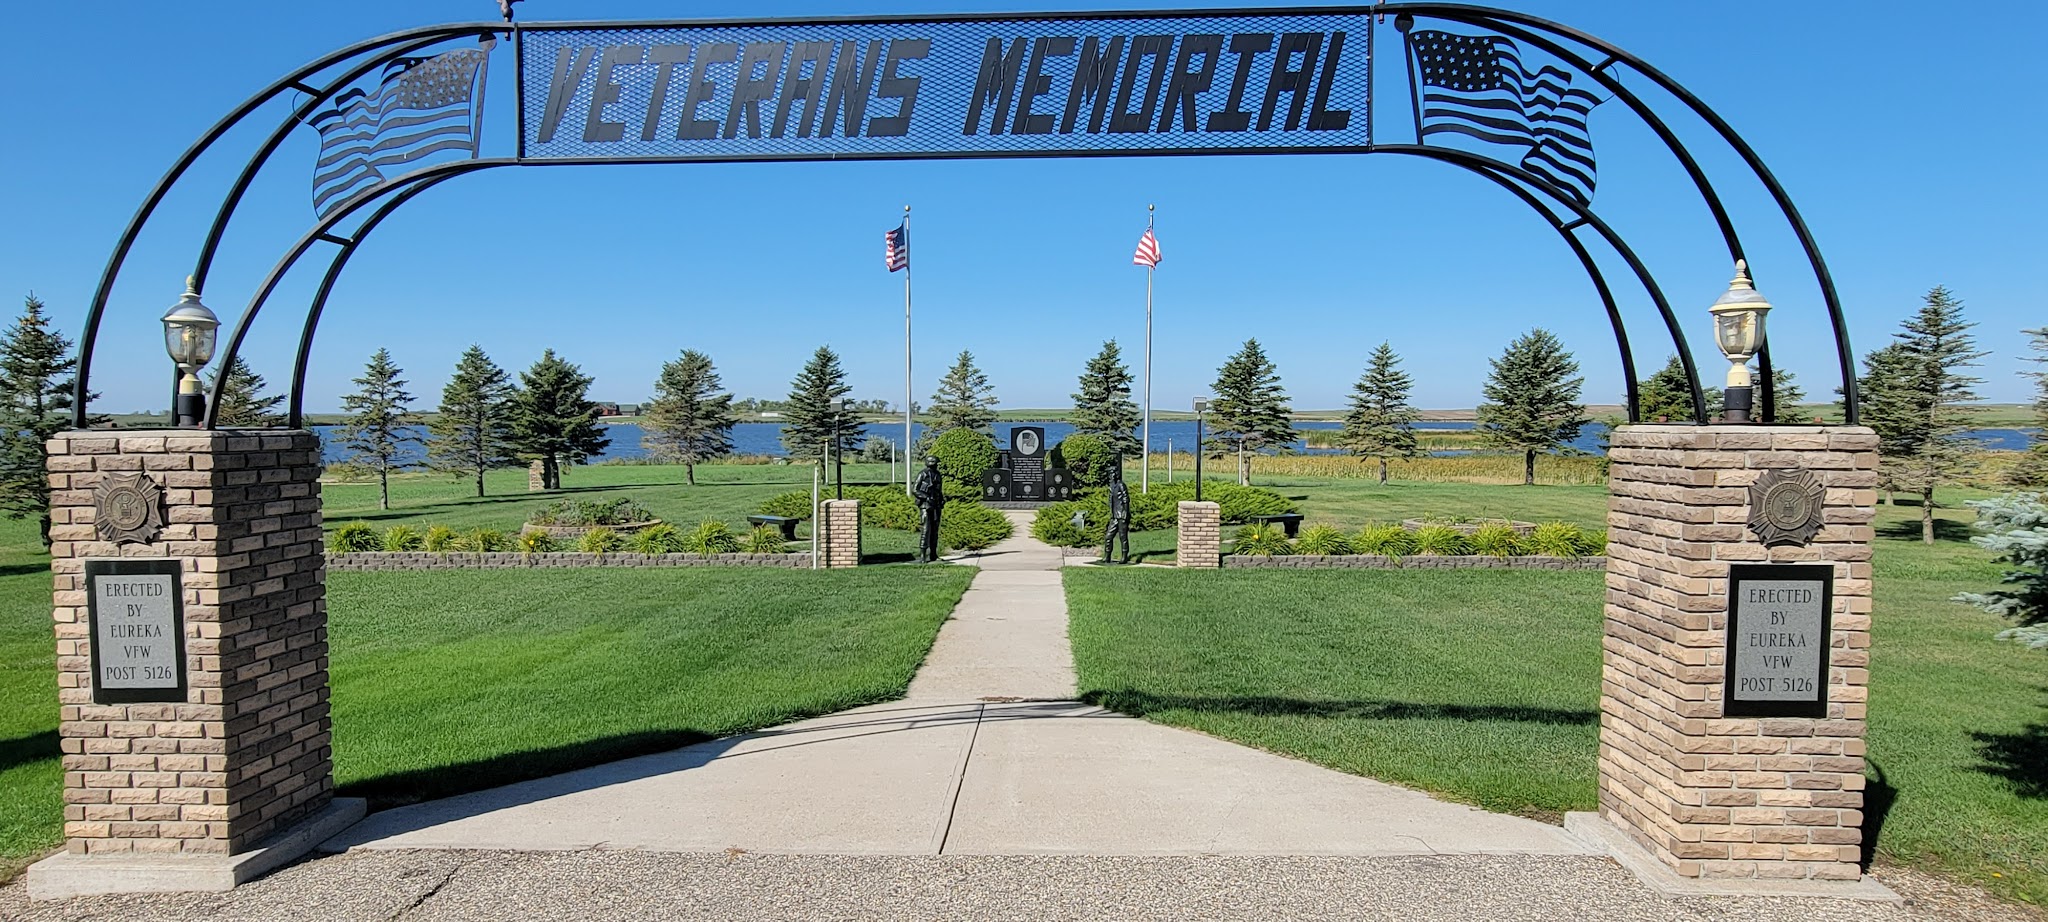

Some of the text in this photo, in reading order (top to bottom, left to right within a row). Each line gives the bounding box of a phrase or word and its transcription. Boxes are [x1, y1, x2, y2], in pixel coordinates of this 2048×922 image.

[537, 31, 1351, 143] VETERANS MEMORIAL
[106, 583, 162, 597] ERECTED
[1750, 589, 1812, 603] ERECTED
[127, 604, 143, 616] BY
[1771, 611, 1788, 625] BY
[111, 625, 162, 638] EUREKA
[1750, 633, 1806, 647] EUREKA
[124, 646, 151, 658] VFW
[1763, 655, 1793, 669] VFW
[106, 666, 172, 679] POST 5126
[1741, 678, 1812, 692] POST 5126
